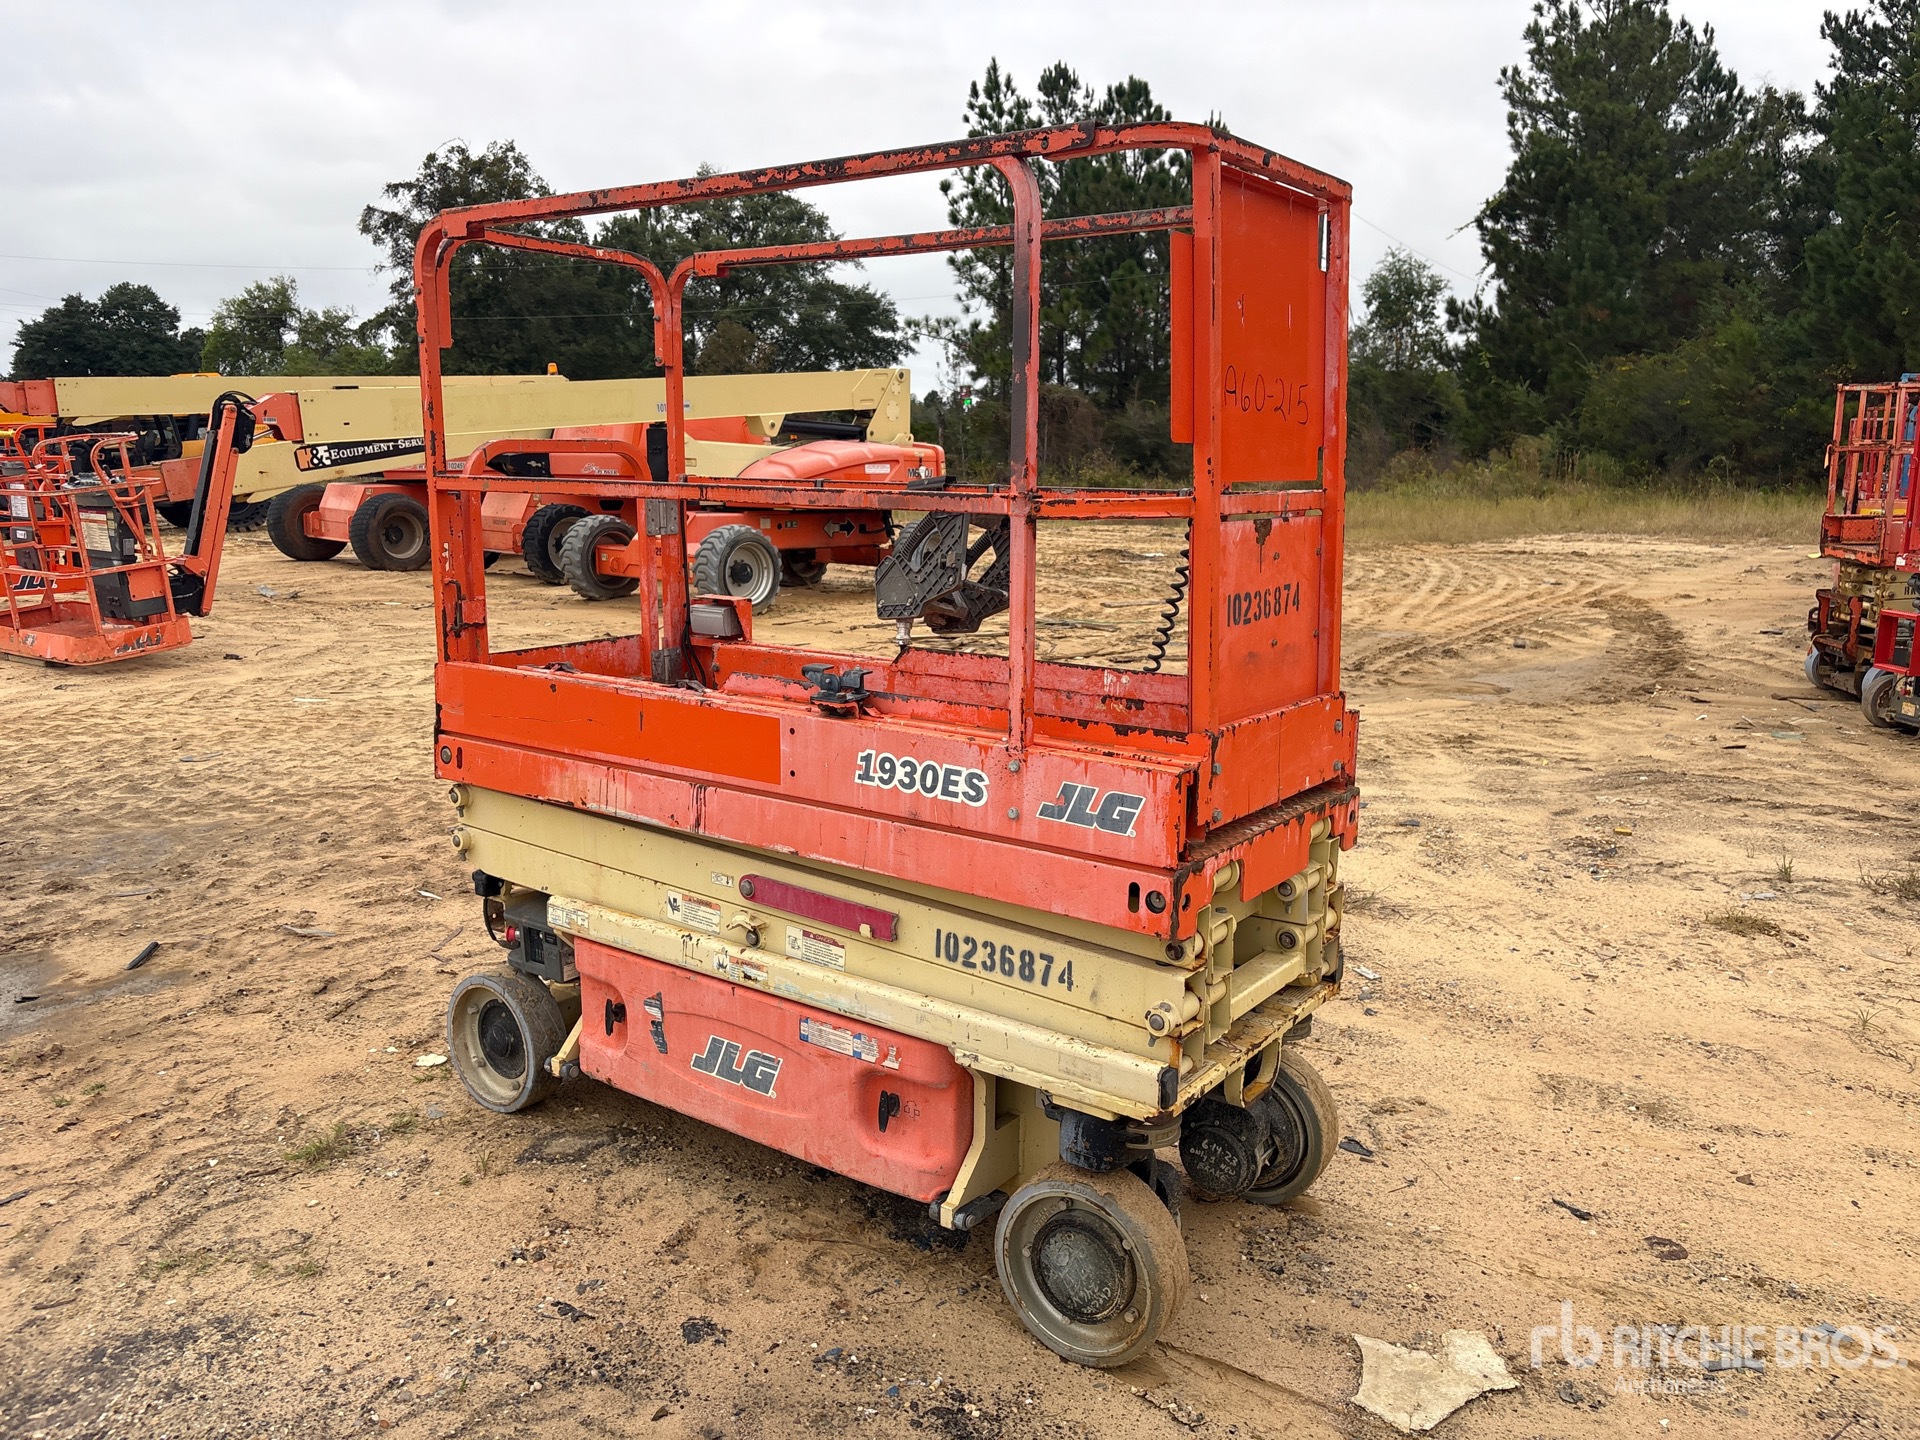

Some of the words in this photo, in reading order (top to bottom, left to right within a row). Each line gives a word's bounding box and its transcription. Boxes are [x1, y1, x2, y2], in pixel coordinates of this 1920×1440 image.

[1223, 364, 1309, 425] A60-215
[330, 442, 394, 460] EQUIPMENT
[908, 468, 934, 479] M60J
[1226, 581, 1300, 627] 10236874
[855, 748, 990, 807] 1930ES
[1037, 781, 1146, 837] JLG
[935, 928, 1074, 992] 10236874
[691, 1034, 783, 1097] JLG
